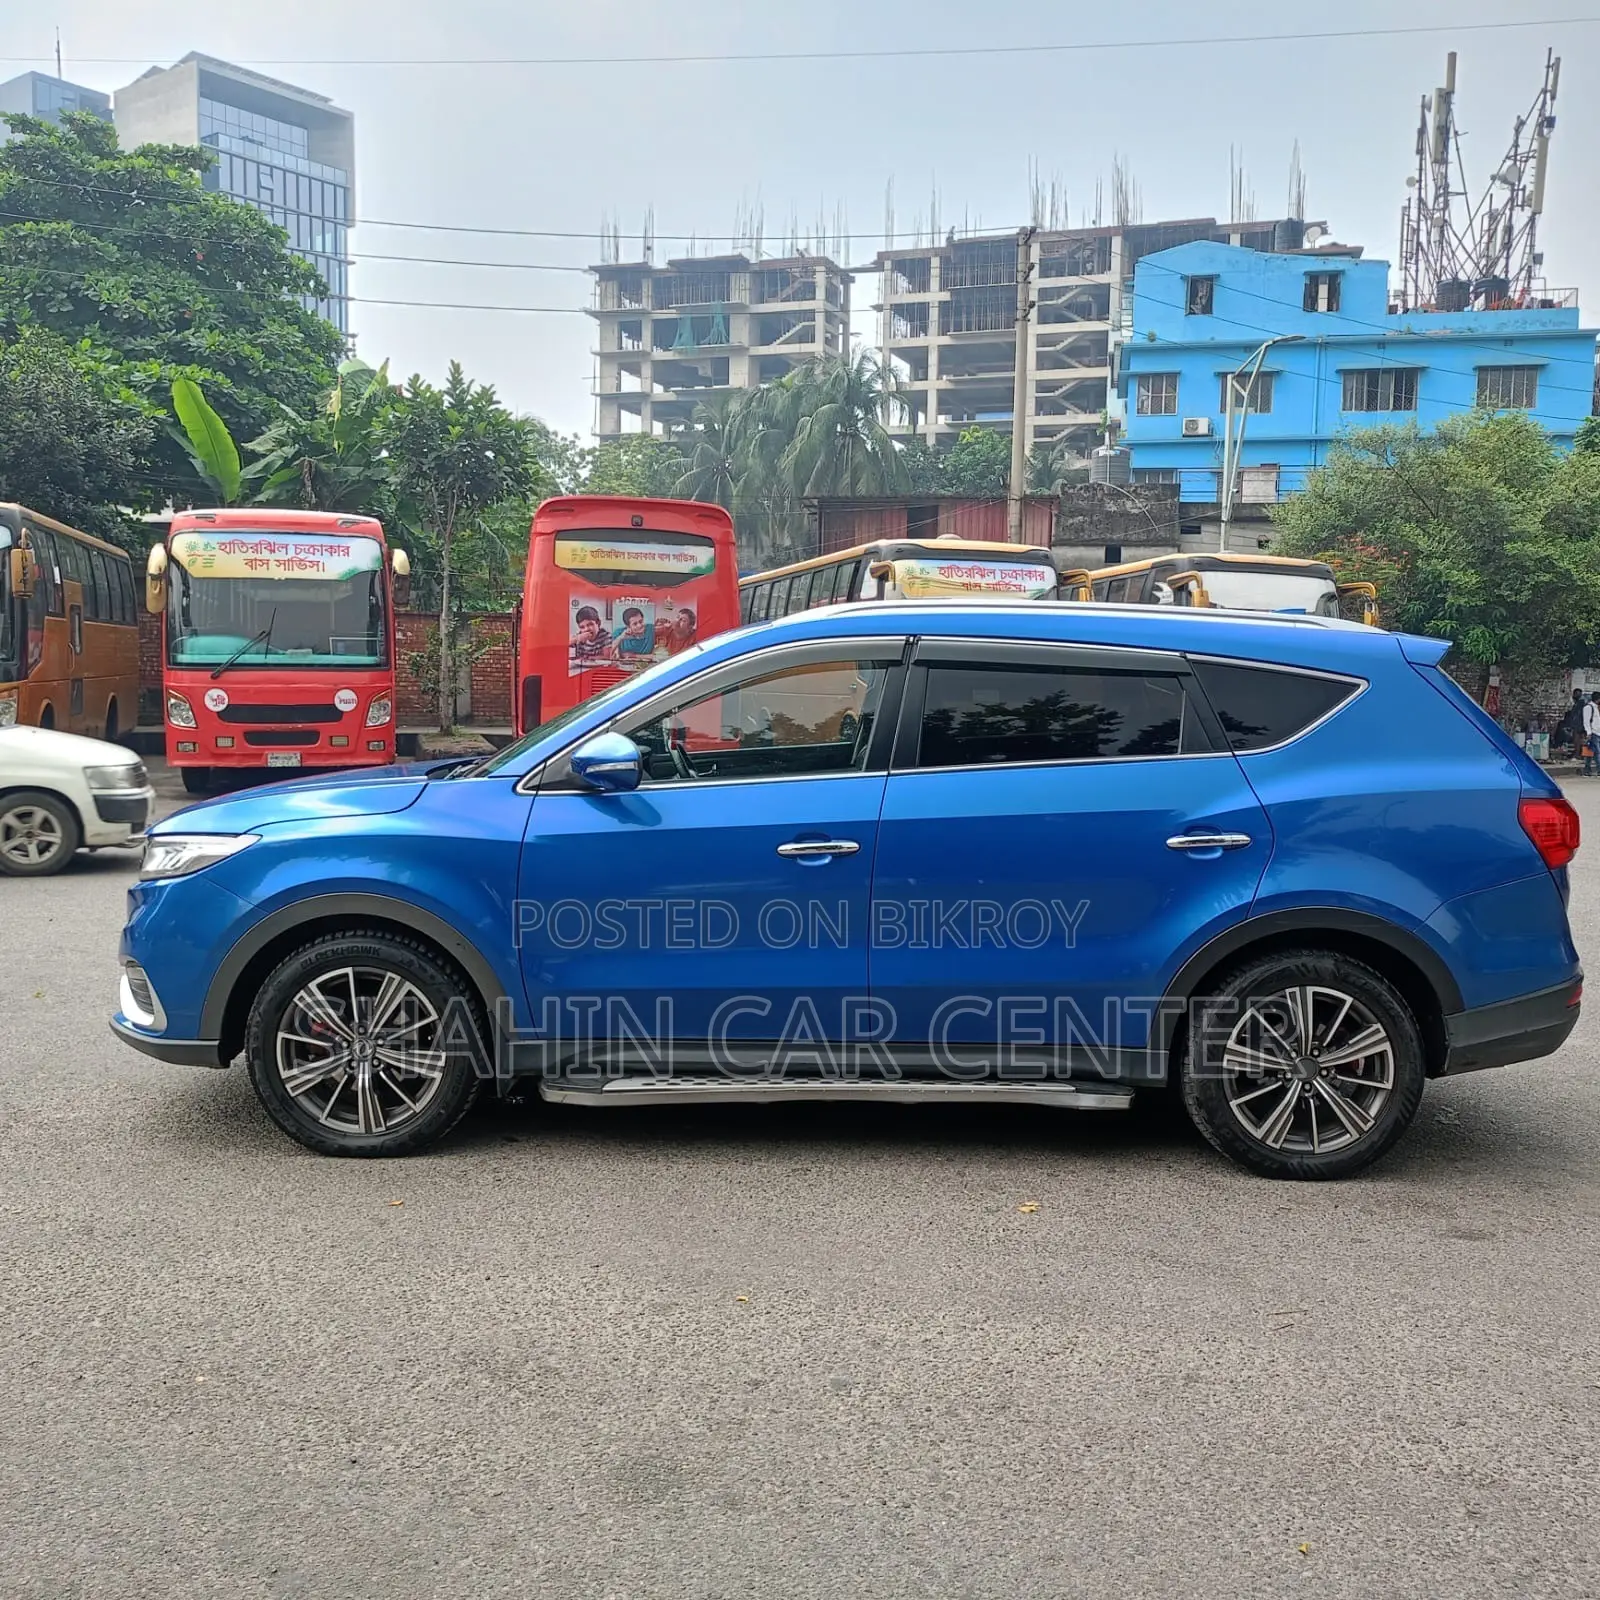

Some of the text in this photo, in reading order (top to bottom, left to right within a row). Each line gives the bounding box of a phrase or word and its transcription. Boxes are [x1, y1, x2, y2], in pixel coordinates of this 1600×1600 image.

[217, 538, 350, 558] হাতিরঝিল চক্রাকার
[244, 557, 270, 572] বাস
[937, 564, 1046, 582] হাতিরঝিল চক্রাকার
